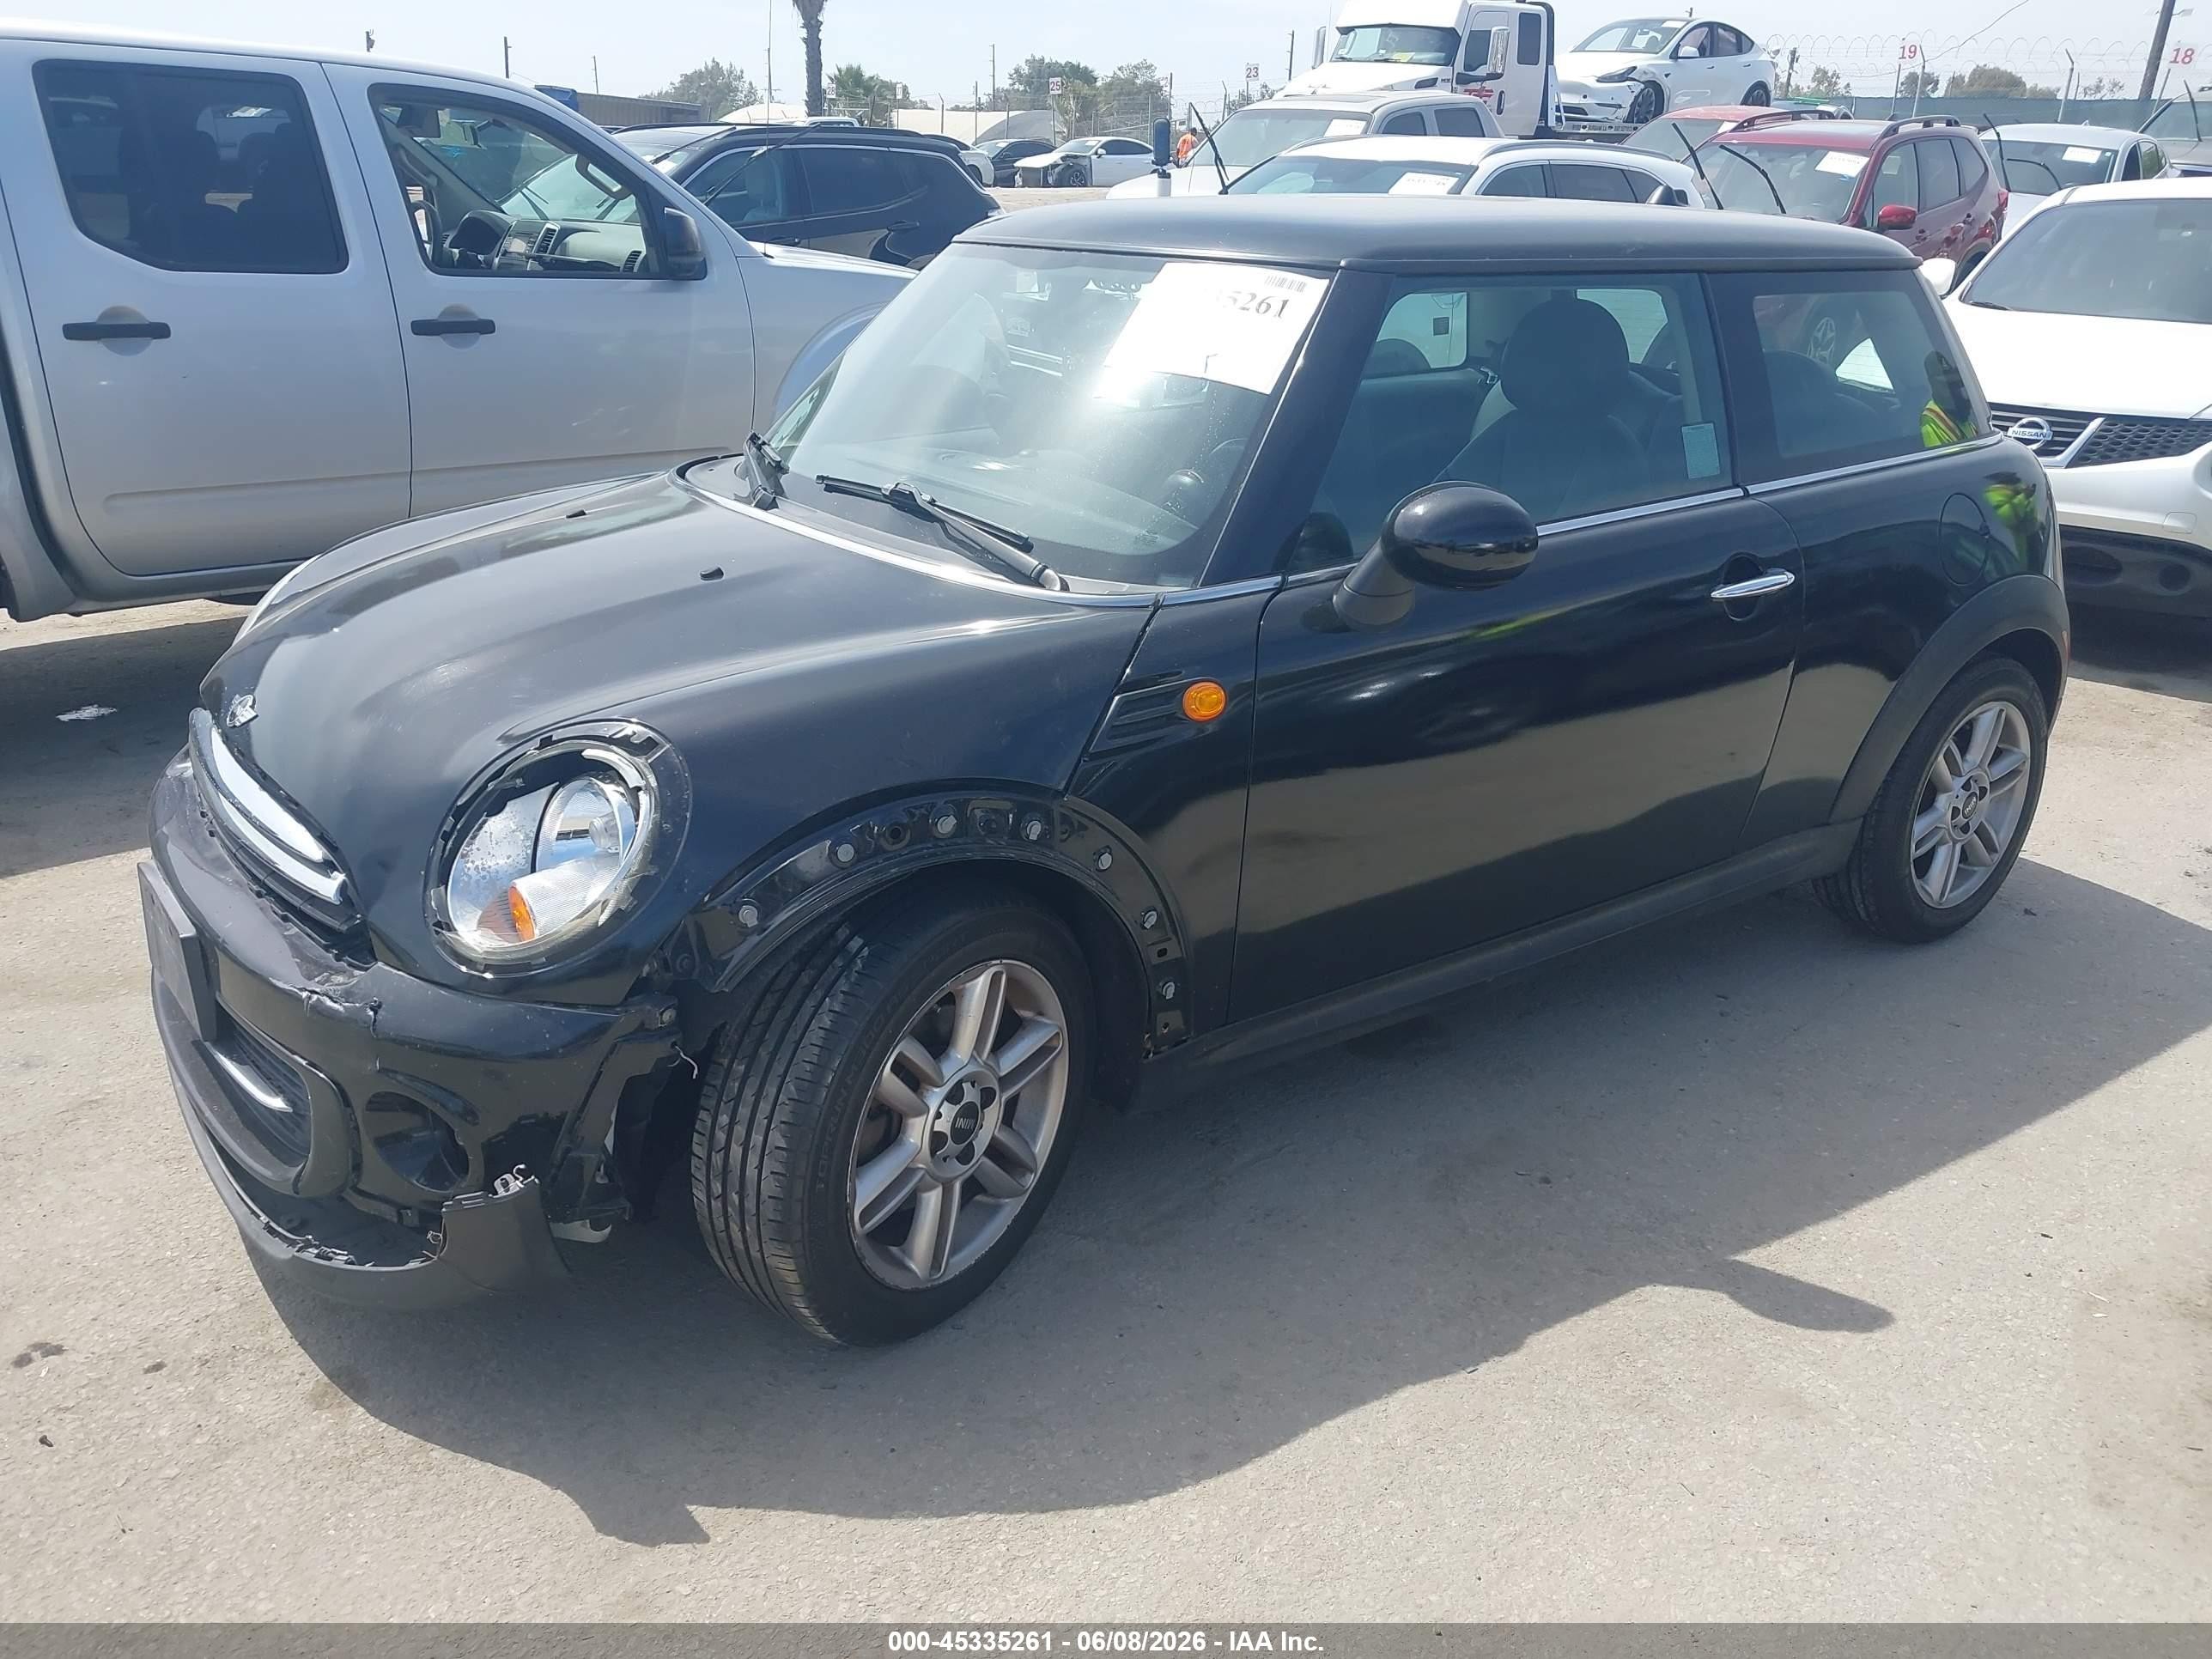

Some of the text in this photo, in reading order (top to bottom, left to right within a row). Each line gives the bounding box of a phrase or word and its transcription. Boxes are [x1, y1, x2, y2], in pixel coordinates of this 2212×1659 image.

[1899, 45, 1917, 59] 19
[2169, 48, 2195, 64] 18
[1246, 67, 1259, 78] 23
[1050, 82, 1060, 91] 25
[2012, 429, 2047, 438] NISSAN
